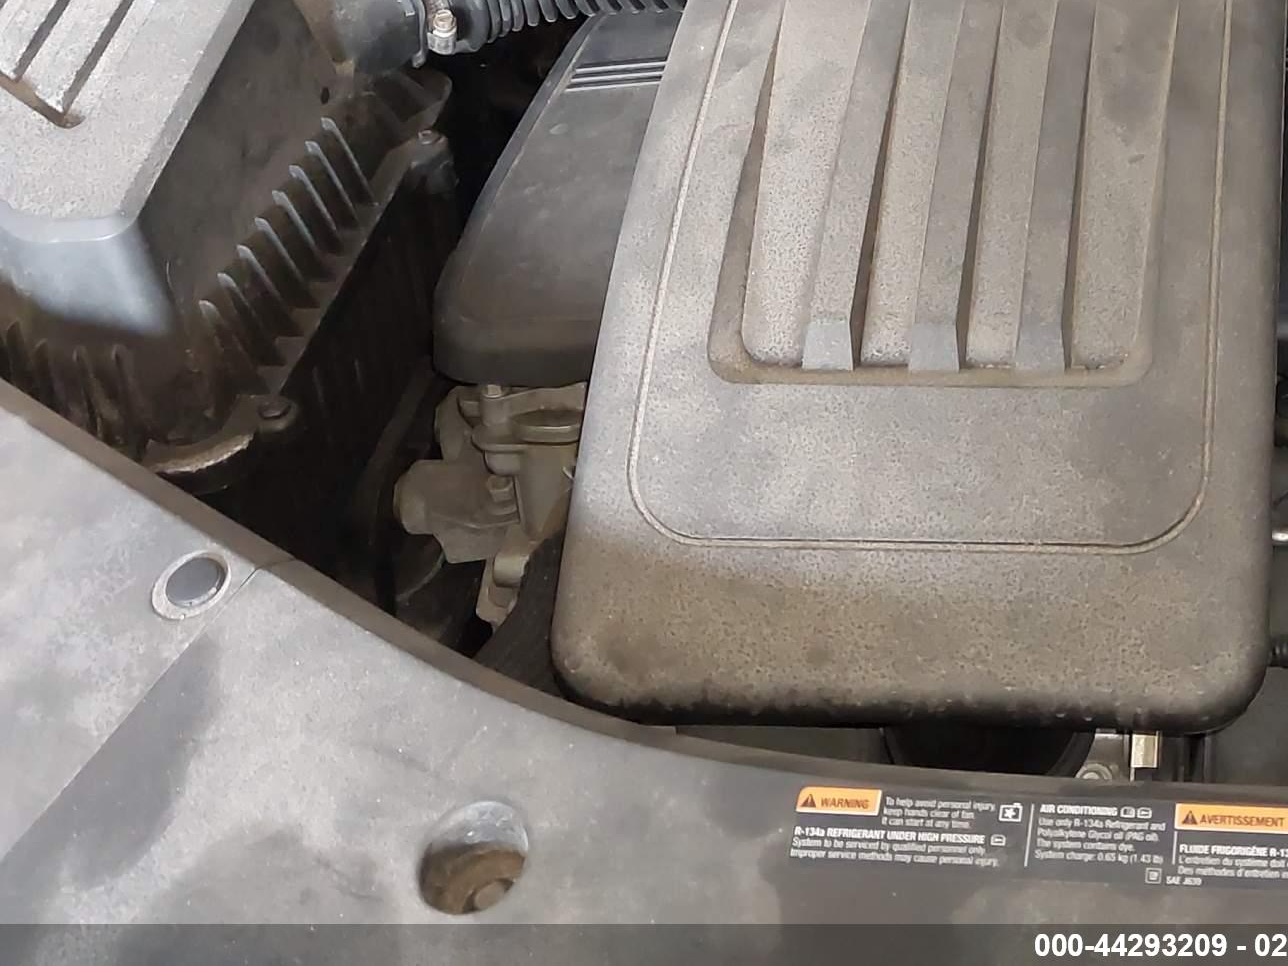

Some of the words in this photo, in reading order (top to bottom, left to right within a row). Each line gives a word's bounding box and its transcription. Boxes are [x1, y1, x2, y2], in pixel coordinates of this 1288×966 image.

[821, 797, 869, 809] WARNING
[896, 797, 913, 808] help
[938, 800, 971, 810] personal
[905, 808, 928, 817] hands
[930, 810, 950, 818] clear
[951, 810, 960, 819] of
[1040, 804, 1055, 813] AIR
[1057, 805, 1118, 816] CONDITIONING
[889, 818, 903, 826] can
[905, 818, 923, 827] start
[935, 820, 949, 829] any
[1055, 819, 1072, 829] only
[1074, 818, 1103, 828] R-134a
[1150, 822, 1166, 831] and
[1200, 814, 1284, 827] AVERTISSEMENT
[795, 826, 825, 837] R-134a
[827, 828, 885, 839] REFRIGERANT
[887, 831, 916, 841] UNDER
[918, 832, 939, 842] HIGH
[941, 833, 985, 844] PRESSURE
[792, 837, 821, 848] System
[824, 839, 832, 847] to
[833, 839, 844, 848] be
[846, 841, 879, 850] serviced
[880, 842, 890, 852] by
[892, 843, 926, 852] qualified
[1037, 838, 1051, 847] The
[1052, 840, 1081, 850] system
[1179, 844, 1210, 854] FLUIDE
[790, 848, 826, 859] Improper
[828, 851, 856, 859] service
[858, 852, 892, 862] methods
[894, 855, 912, 864] may
[913, 855, 937, 863] cause
[939, 856, 973, 865] personal
[1035, 849, 1064, 860] System
[1118, 853, 1128, 864] kg
[1178, 866, 1193, 875] Des
[1166, 876, 1180, 885] SAE
